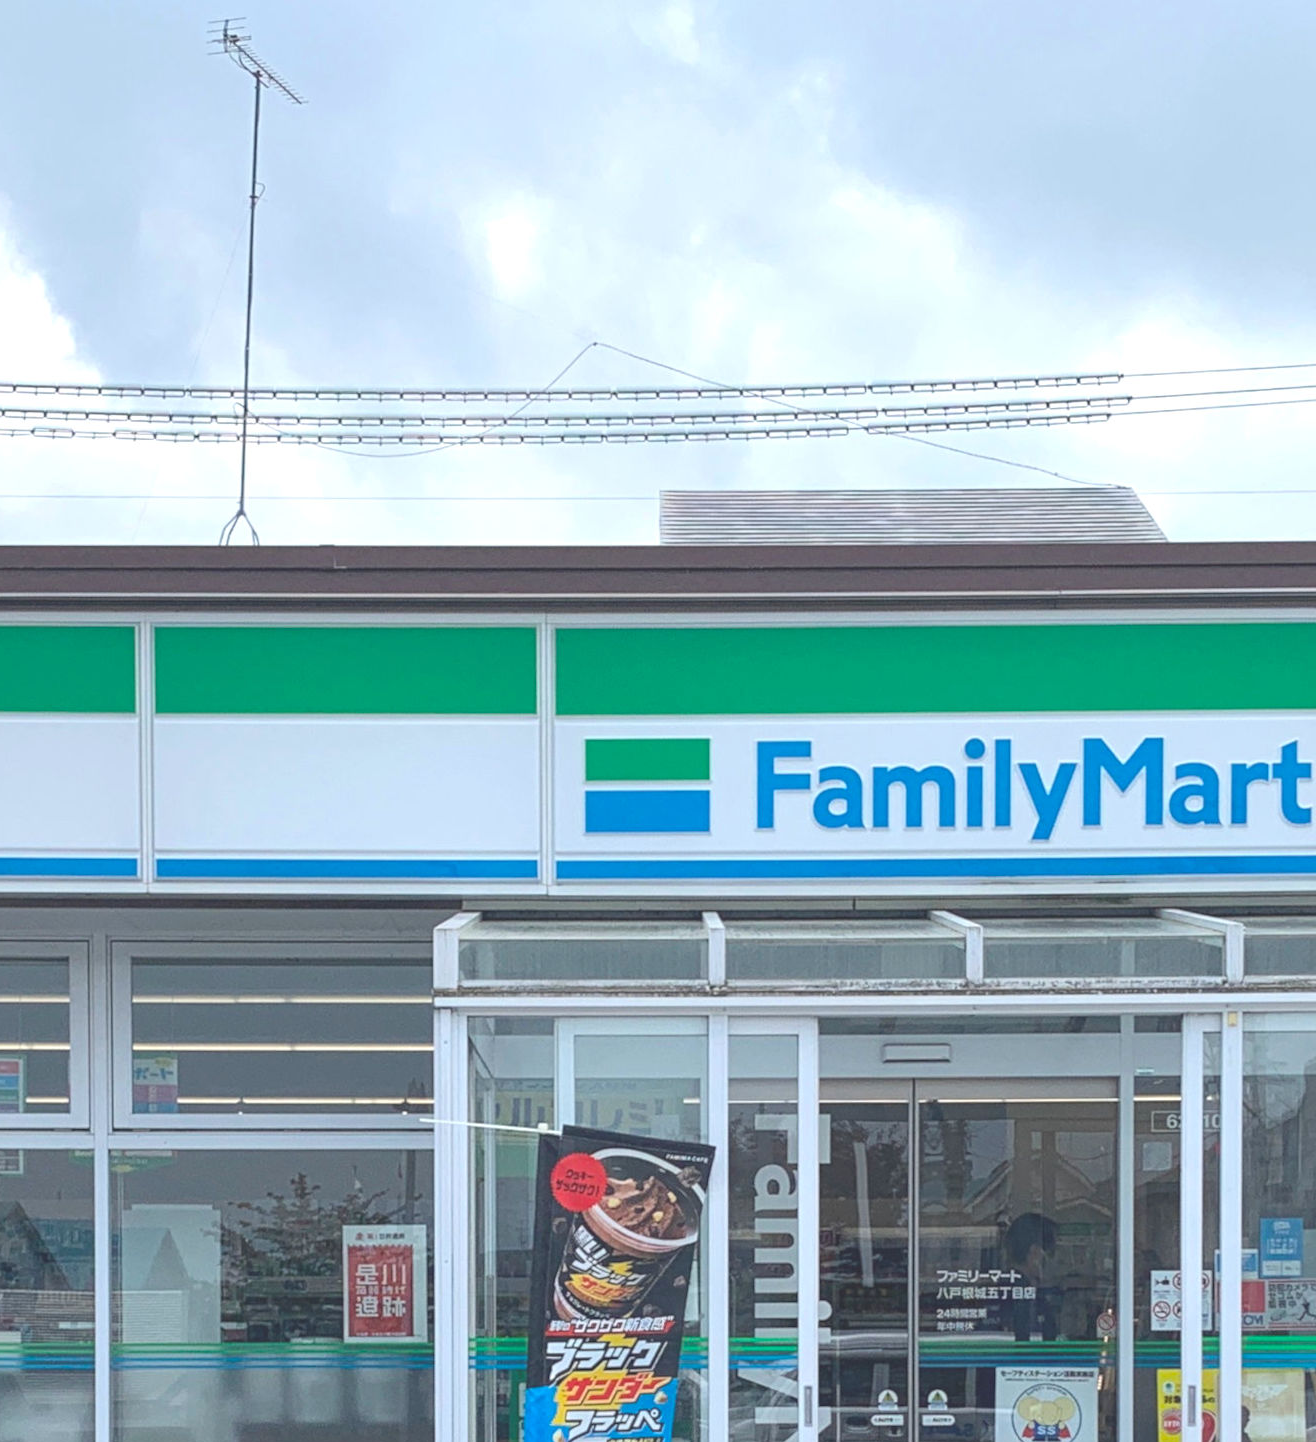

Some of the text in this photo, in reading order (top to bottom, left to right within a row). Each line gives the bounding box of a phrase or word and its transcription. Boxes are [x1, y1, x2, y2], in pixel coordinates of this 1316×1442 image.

[756, 737, 1312, 841] FamilyMart
[134, 1068, 174, 1080] ポート
[355, 1263, 407, 1285] 是川
[936, 1269, 1021, 1283] ファミリーマート
[936, 1286, 1037, 1300] 八戸根城五丁目店
[355, 1296, 407, 1317] 遺跡
[546, 1338, 661, 1381] ブラック
[565, 1372, 671, 1402] サンダー
[566, 1409, 662, 1442] フラッペ
